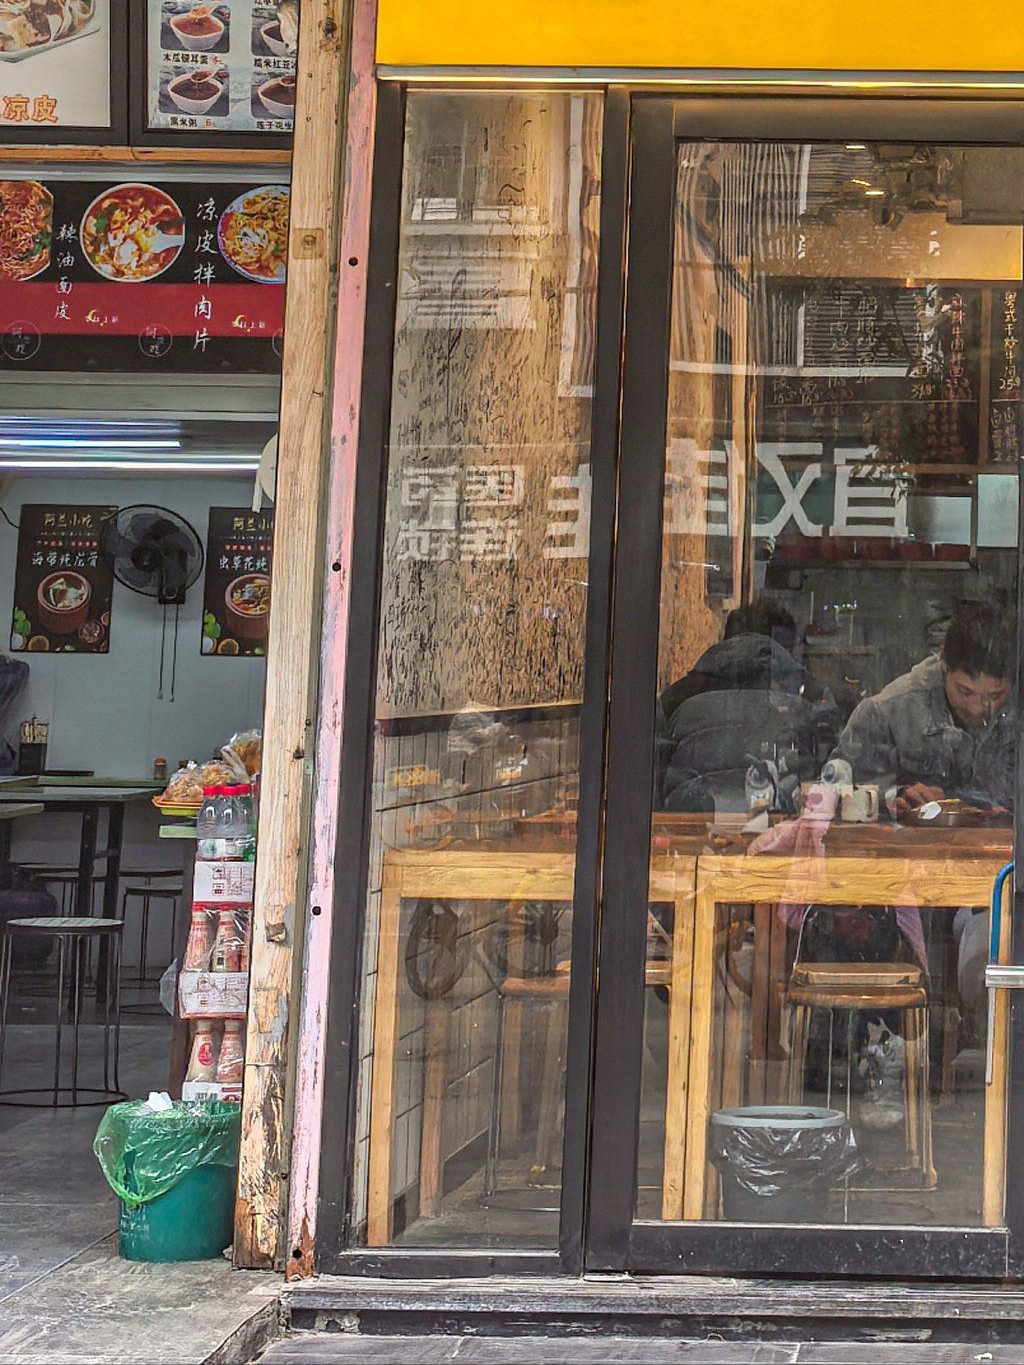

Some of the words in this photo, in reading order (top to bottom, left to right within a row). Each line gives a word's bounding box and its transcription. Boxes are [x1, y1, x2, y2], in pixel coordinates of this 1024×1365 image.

[3, 94, 58, 123] 凉皮
[55, 224, 78, 320] 辣油面皮
[193, 197, 219, 352] 凉皮拌肉片
[233, 517, 273, 531] 阿兰小
